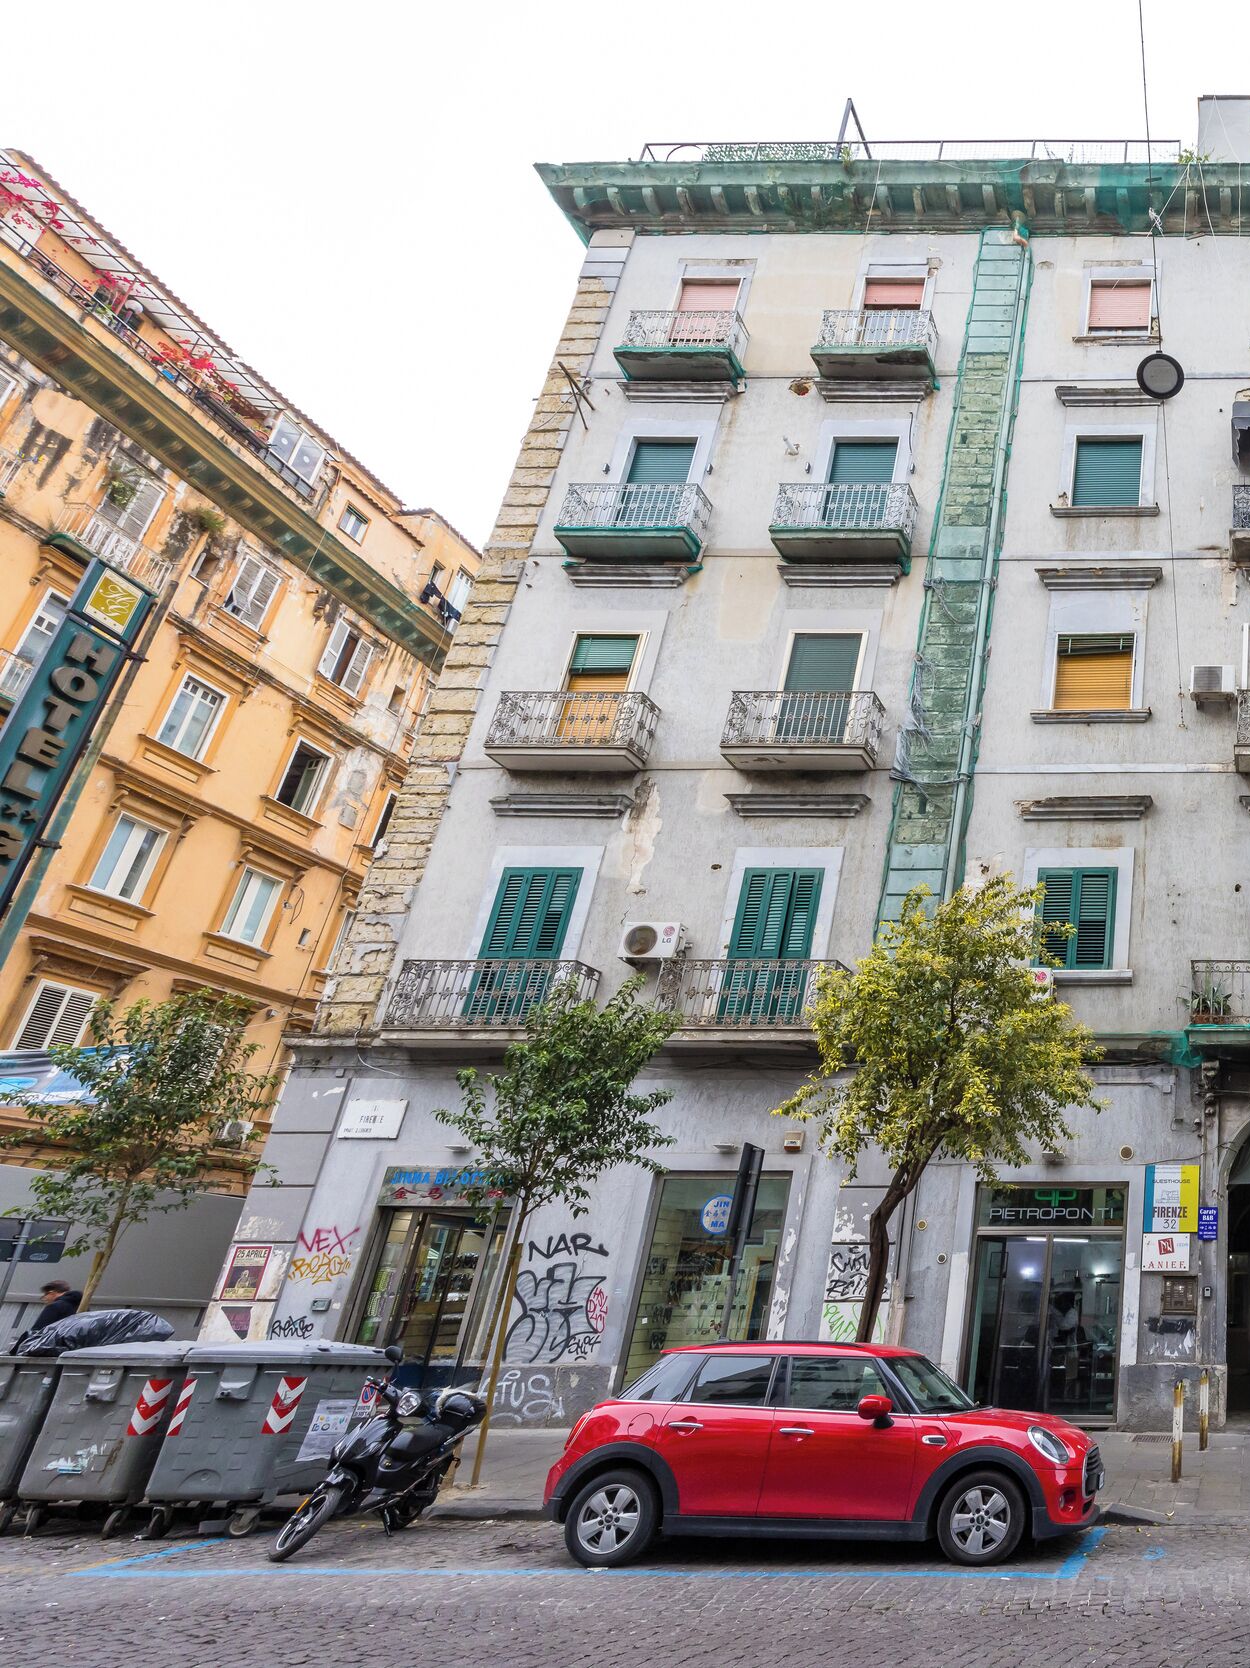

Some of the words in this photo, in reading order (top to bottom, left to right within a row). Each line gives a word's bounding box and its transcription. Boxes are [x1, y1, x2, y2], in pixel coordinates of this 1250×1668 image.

[1, 632, 116, 801] HOTEL
[713, 1200, 730, 1208] JIN
[989, 1206, 1114, 1220] PIETROPONTI
[1152, 1206, 1188, 1219] FIRENZE
[1162, 1218, 1177, 1230] 32
[236, 1249, 246, 1259] 25
[245, 1249, 269, 1259] APRILE
